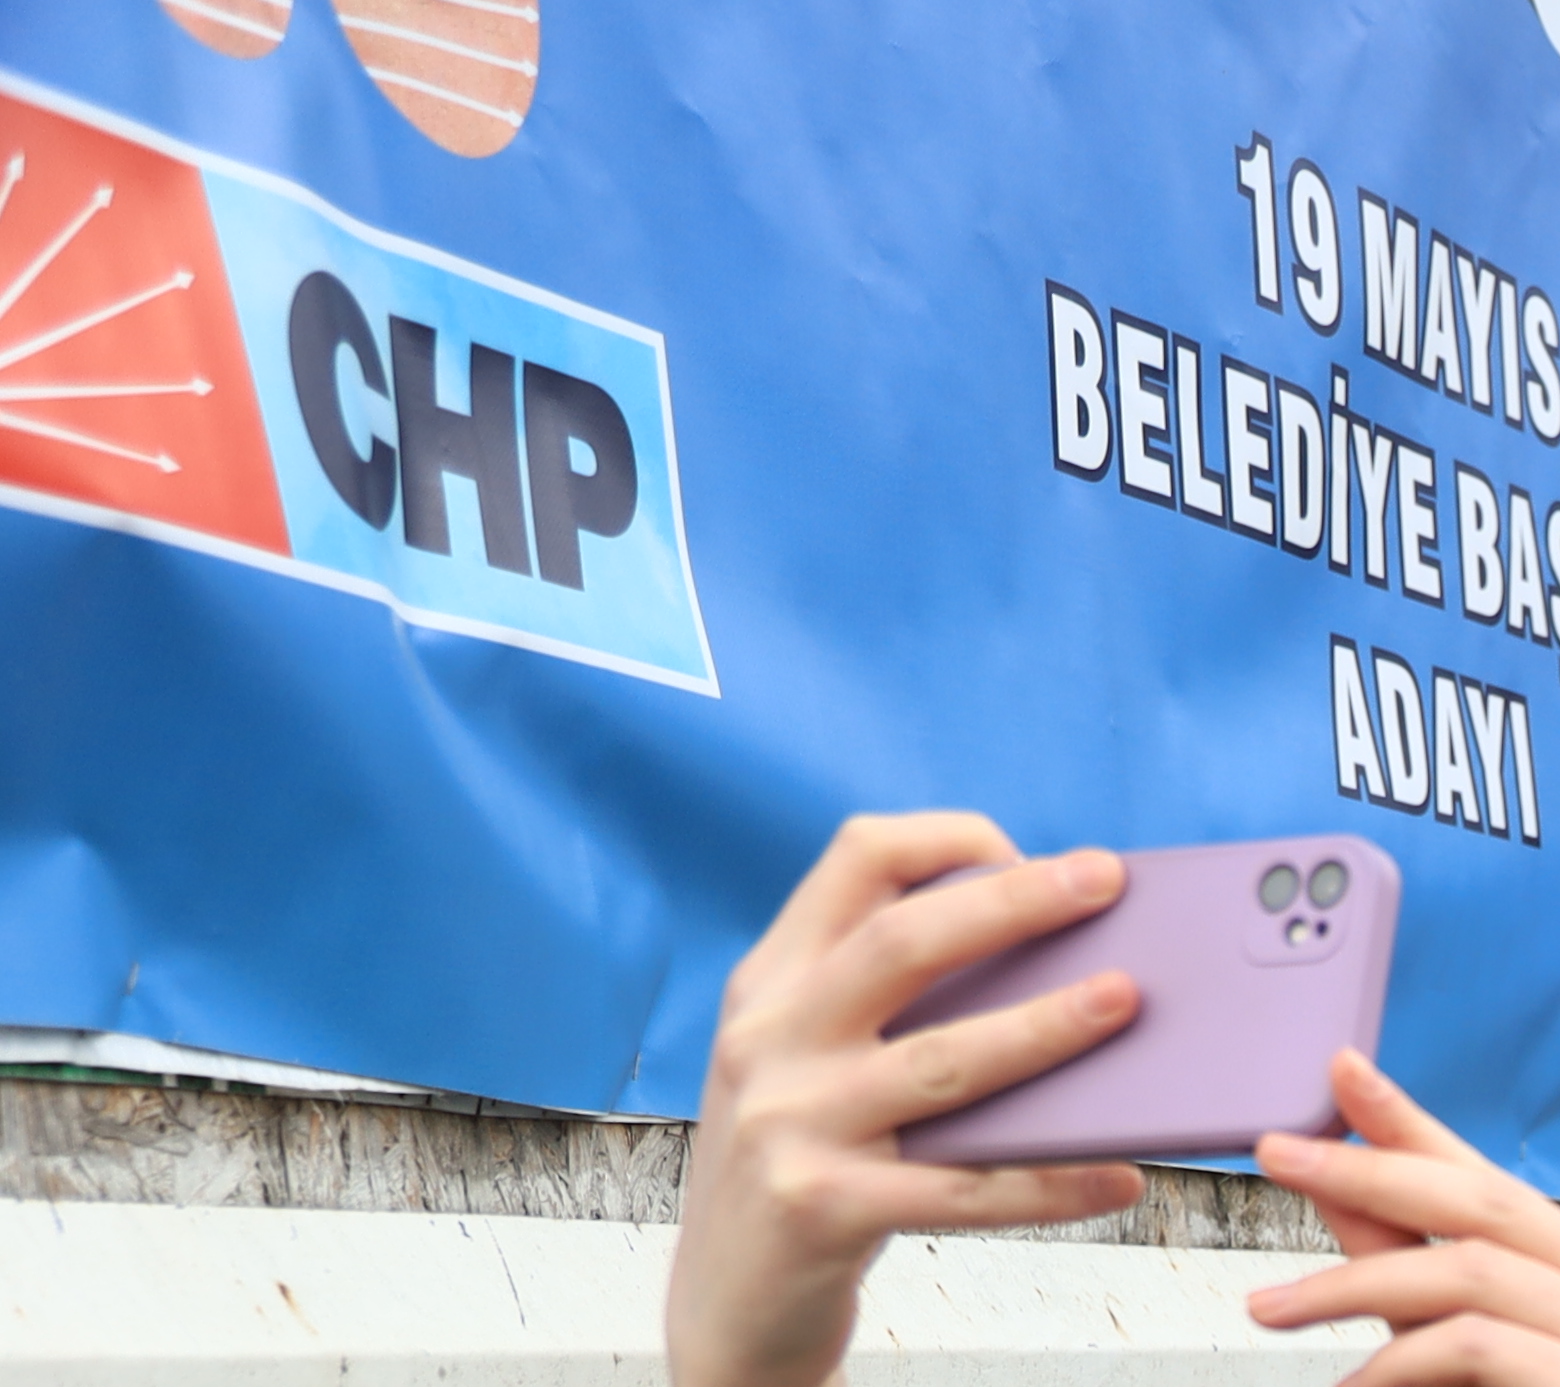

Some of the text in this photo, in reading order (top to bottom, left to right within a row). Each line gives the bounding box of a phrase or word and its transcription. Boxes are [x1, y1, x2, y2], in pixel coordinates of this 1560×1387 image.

[1236, 130, 1340, 335] 19
[288, 269, 640, 592] CHP
[1046, 279, 1445, 610] BELEDİYE
[1328, 633, 1541, 847] ADAYI
